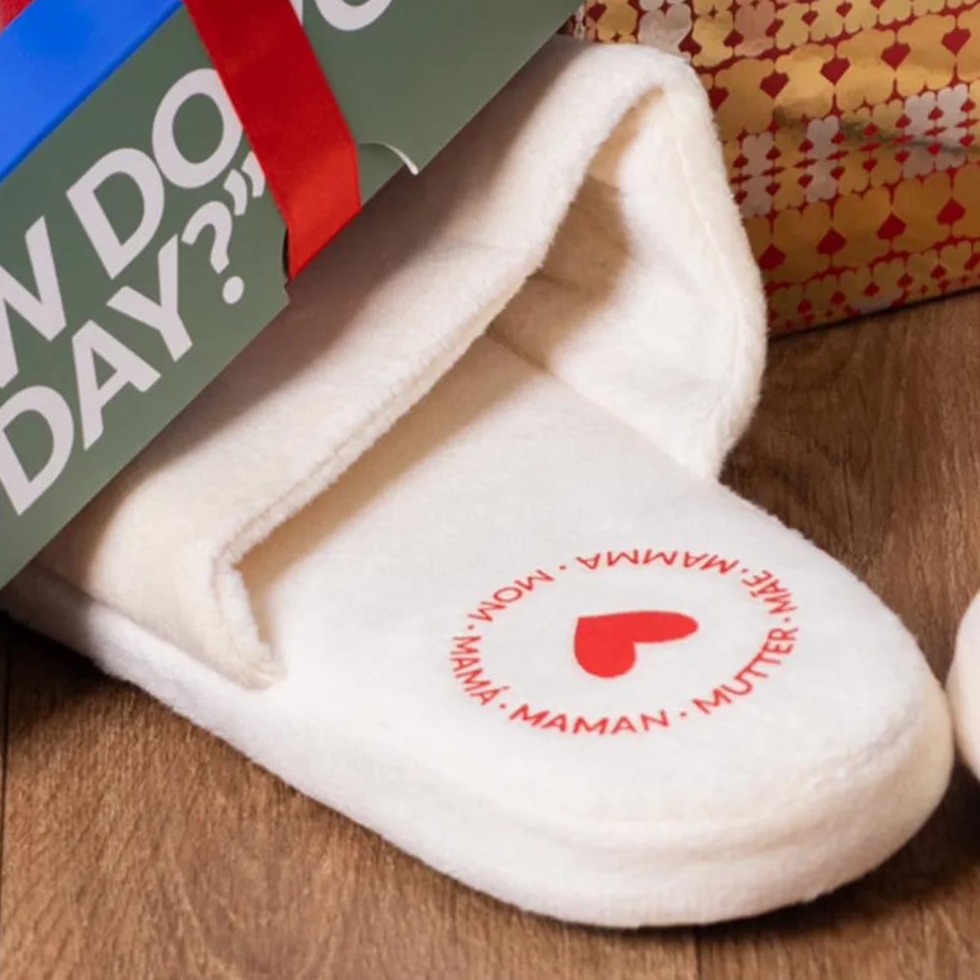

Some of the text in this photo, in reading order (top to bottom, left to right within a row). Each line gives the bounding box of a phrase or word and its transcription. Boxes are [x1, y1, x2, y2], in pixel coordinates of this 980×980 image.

[66, 68, 244, 281] DO
[575, 549, 739, 574] MAMMA
[468, 569, 555, 622] MOM
[450, 635, 510, 706] MAMÁ
[692, 627, 798, 715] MUTTER
[509, 704, 671, 735] MAMAN
